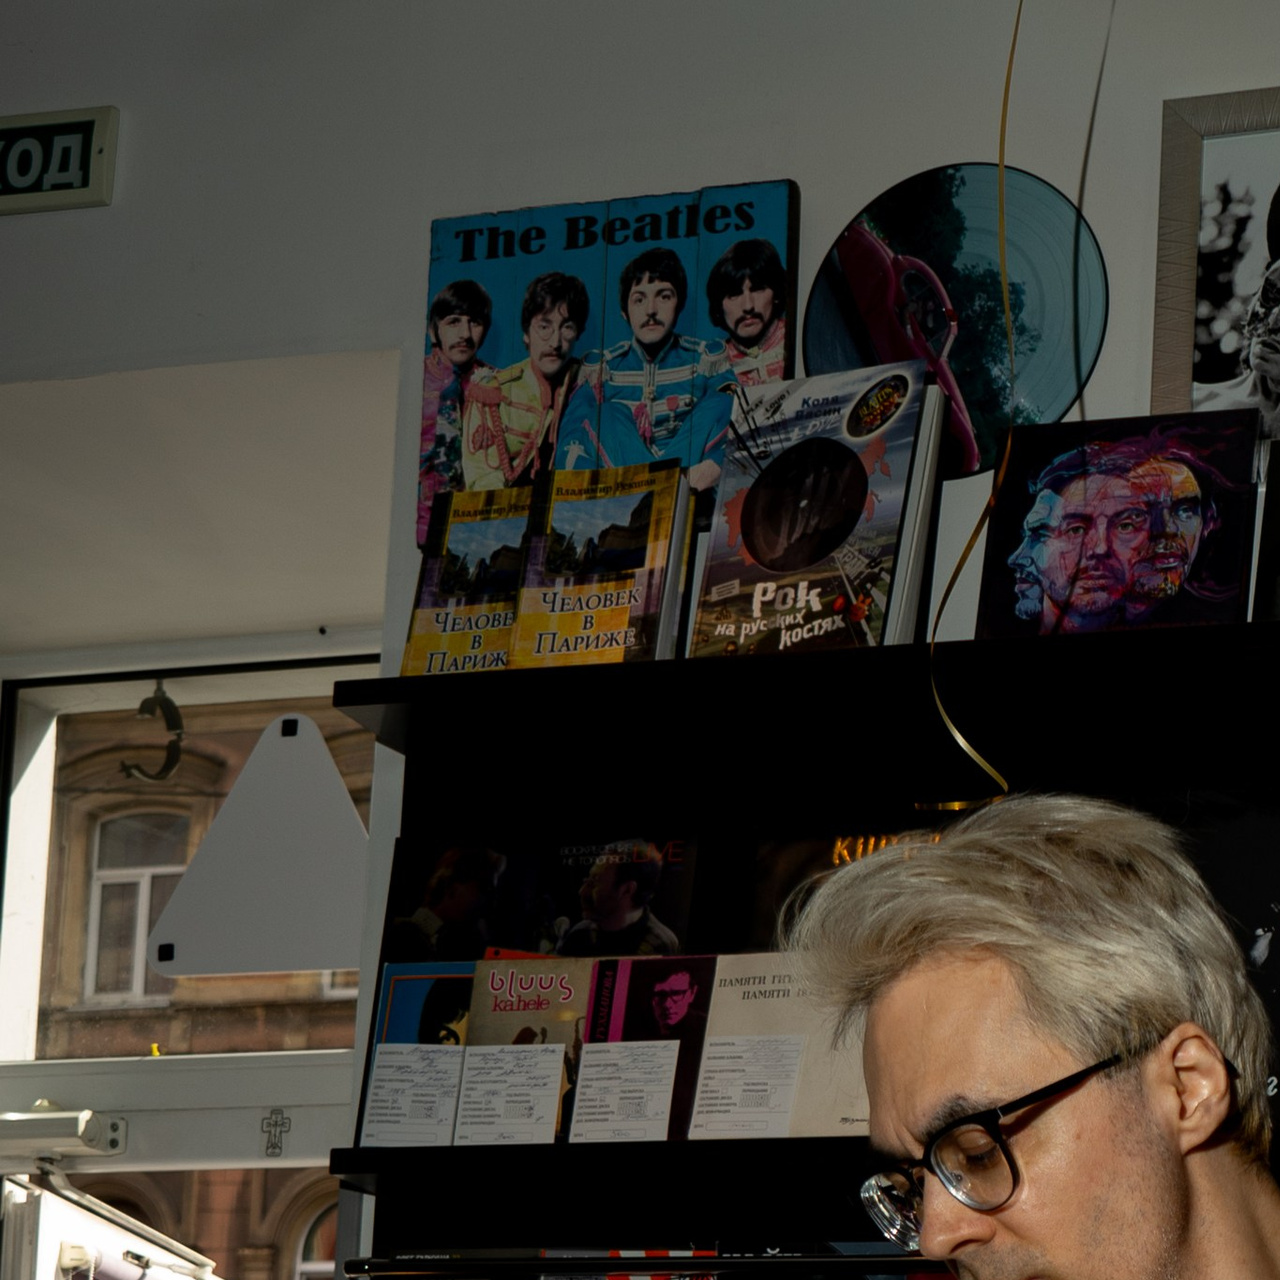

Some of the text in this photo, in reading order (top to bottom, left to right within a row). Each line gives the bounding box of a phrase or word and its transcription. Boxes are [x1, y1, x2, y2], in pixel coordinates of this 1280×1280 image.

[0, 133, 83, 191] ОД
[455, 201, 756, 262] The Beatles
[801, 396, 839, 409] Коля
[556, 484, 612, 497] Владимир
[541, 587, 642, 613] ЧЕЛОВЕК
[752, 580, 823, 618] Рок
[582, 615, 595, 631] В
[715, 609, 806, 643] на русских
[779, 615, 846, 650] костях
[471, 634, 483, 650] В
[535, 628, 636, 655] ПАРИЖЕ
[490, 970, 574, 1002] bluus
[719, 976, 767, 988] ПАМЯТИ
[742, 989, 790, 1000] ПАМЯТИ
